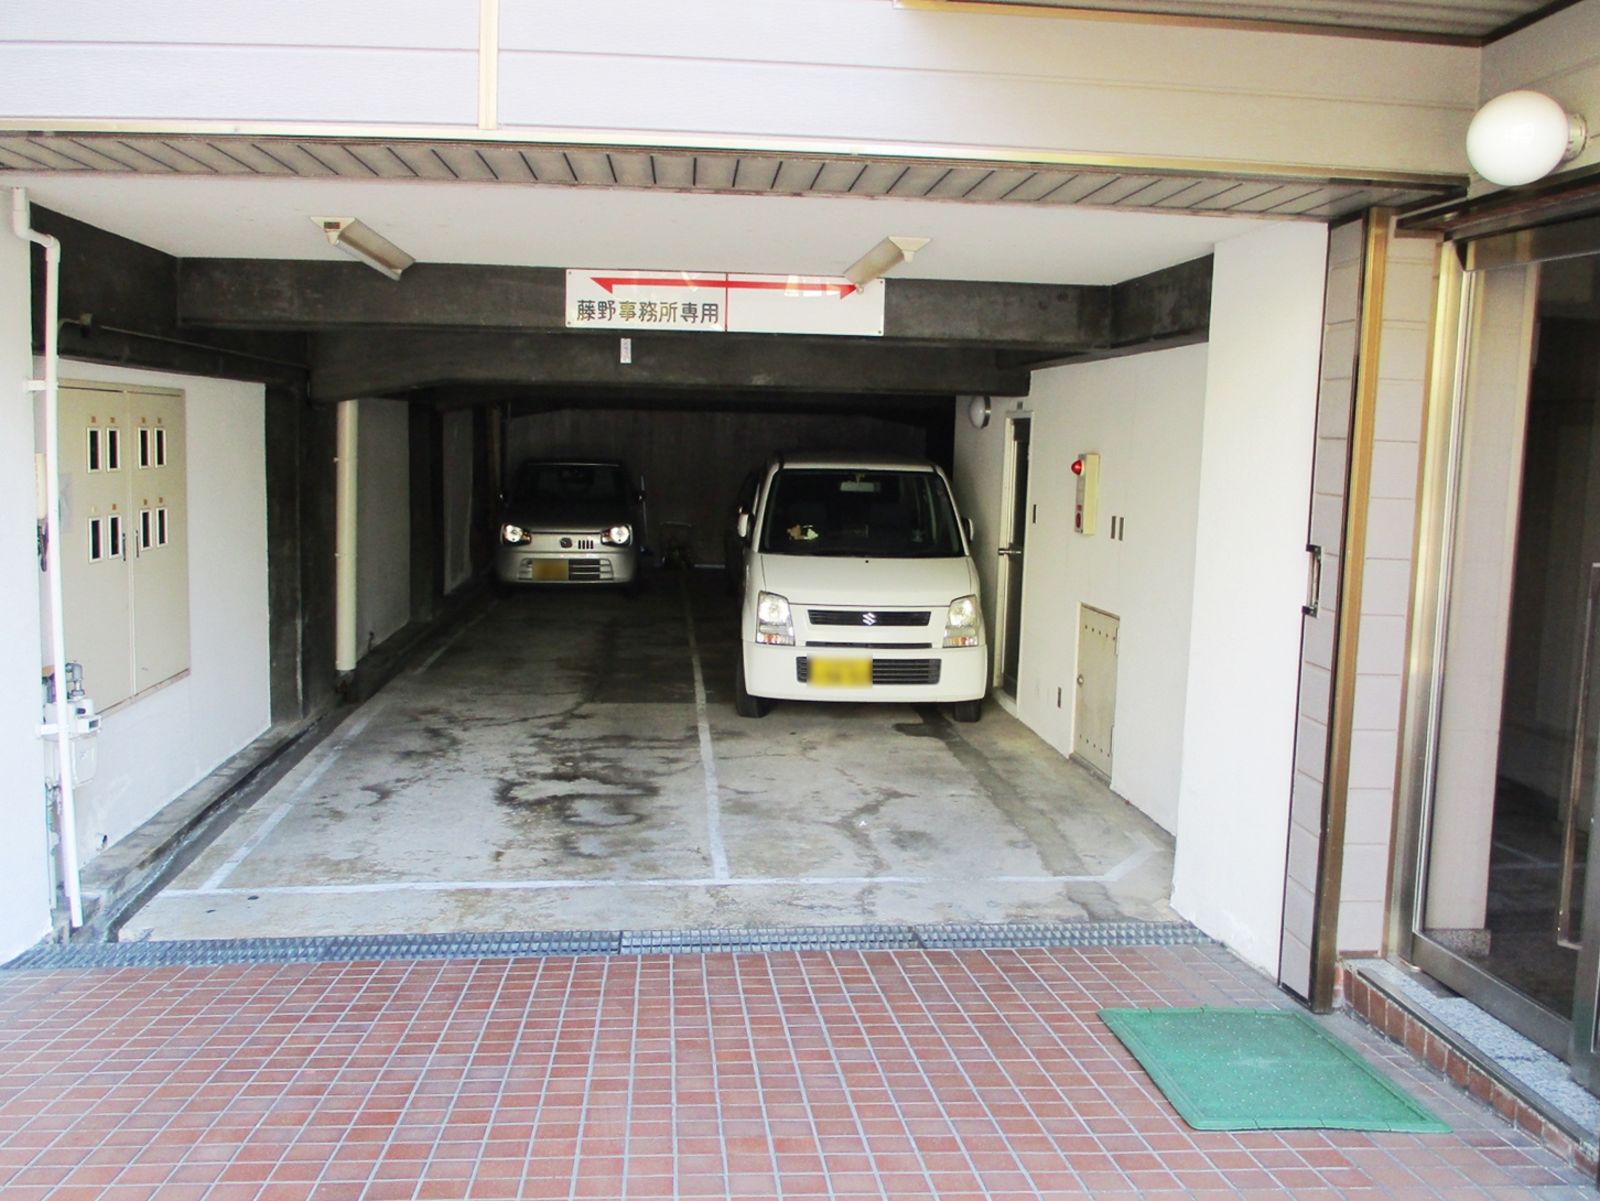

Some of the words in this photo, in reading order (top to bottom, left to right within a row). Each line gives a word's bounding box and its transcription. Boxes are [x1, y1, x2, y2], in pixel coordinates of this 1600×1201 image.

[576, 299, 719, 324] 藤野事務所専用
